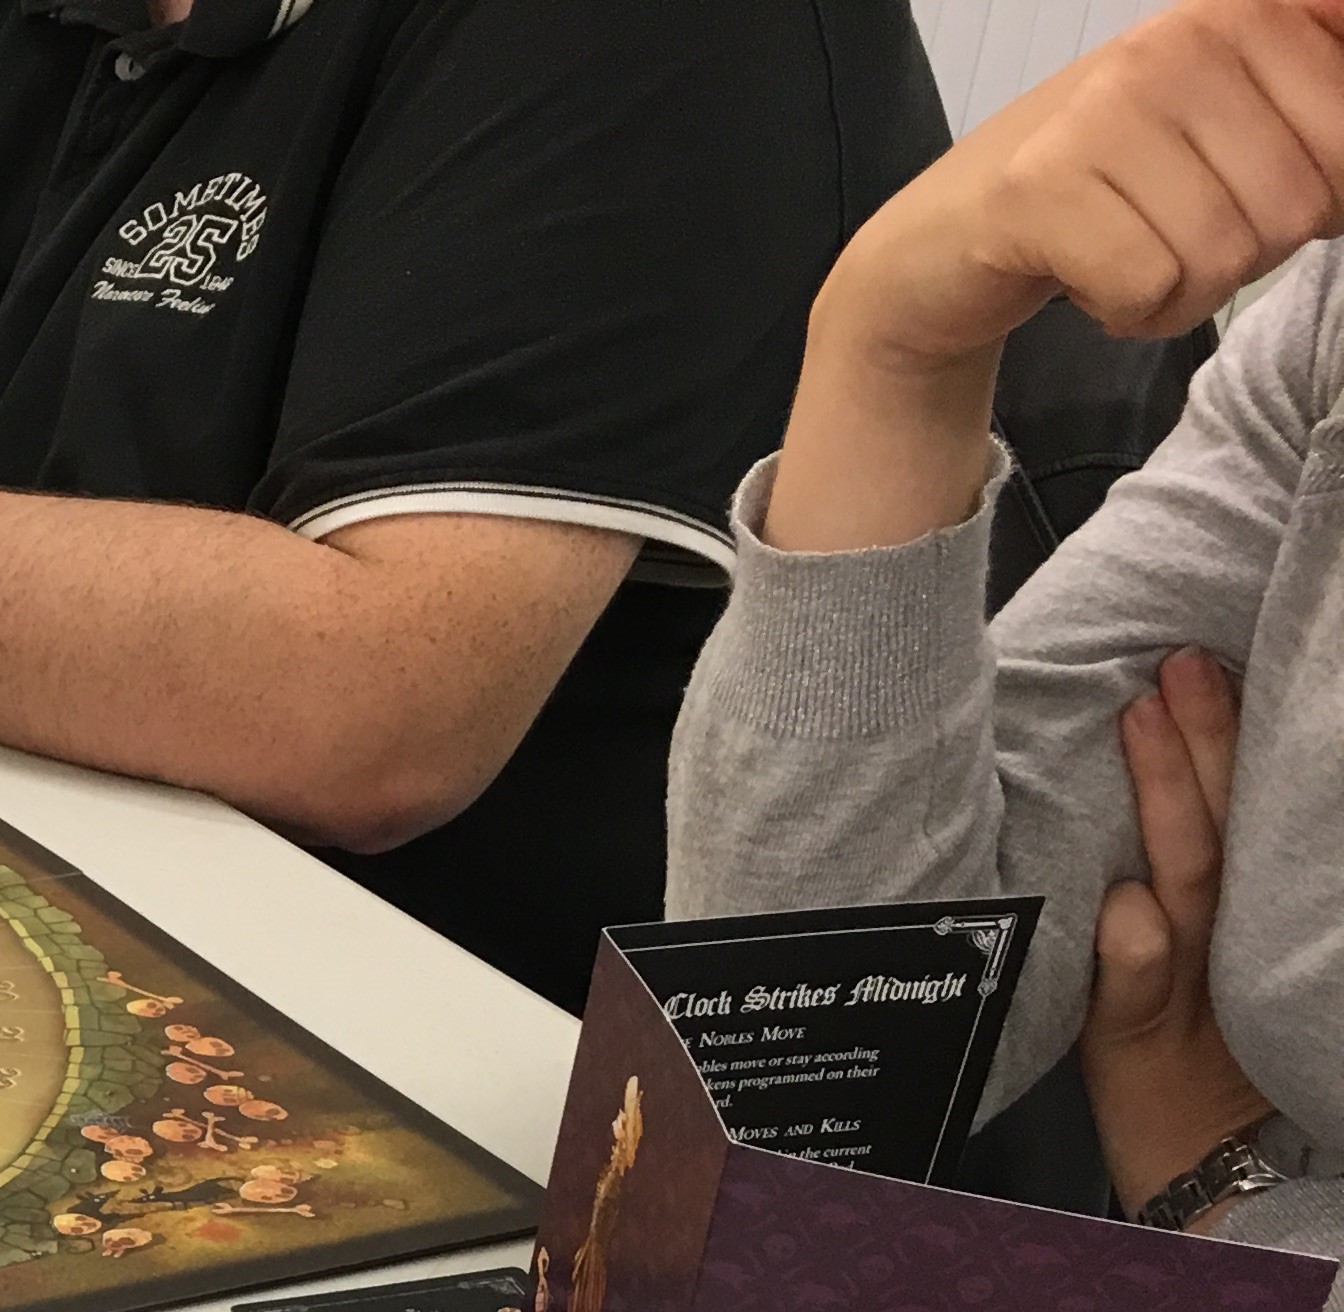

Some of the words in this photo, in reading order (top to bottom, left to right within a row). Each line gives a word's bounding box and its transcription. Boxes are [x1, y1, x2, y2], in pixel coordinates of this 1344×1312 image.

[118, 171, 269, 262] SOMETIMES
[136, 213, 239, 285] 25
[664, 989, 732, 1021] Clock
[739, 982, 841, 1013] Strikes
[844, 972, 966, 1006] Midnight
[698, 1030, 753, 1048] NOBLES
[759, 1024, 806, 1042] MOVE
[729, 1058, 767, 1071] move
[767, 1056, 785, 1067] or
[784, 1054, 813, 1068] stay
[813, 1045, 880, 1063] according
[736, 1066, 825, 1092] programmed
[825, 1069, 844, 1080] on
[845, 1064, 880, 1078] their
[783, 1123, 814, 1137] AND
[819, 1117, 861, 1133] KILLS
[822, 1144, 872, 1158] current
